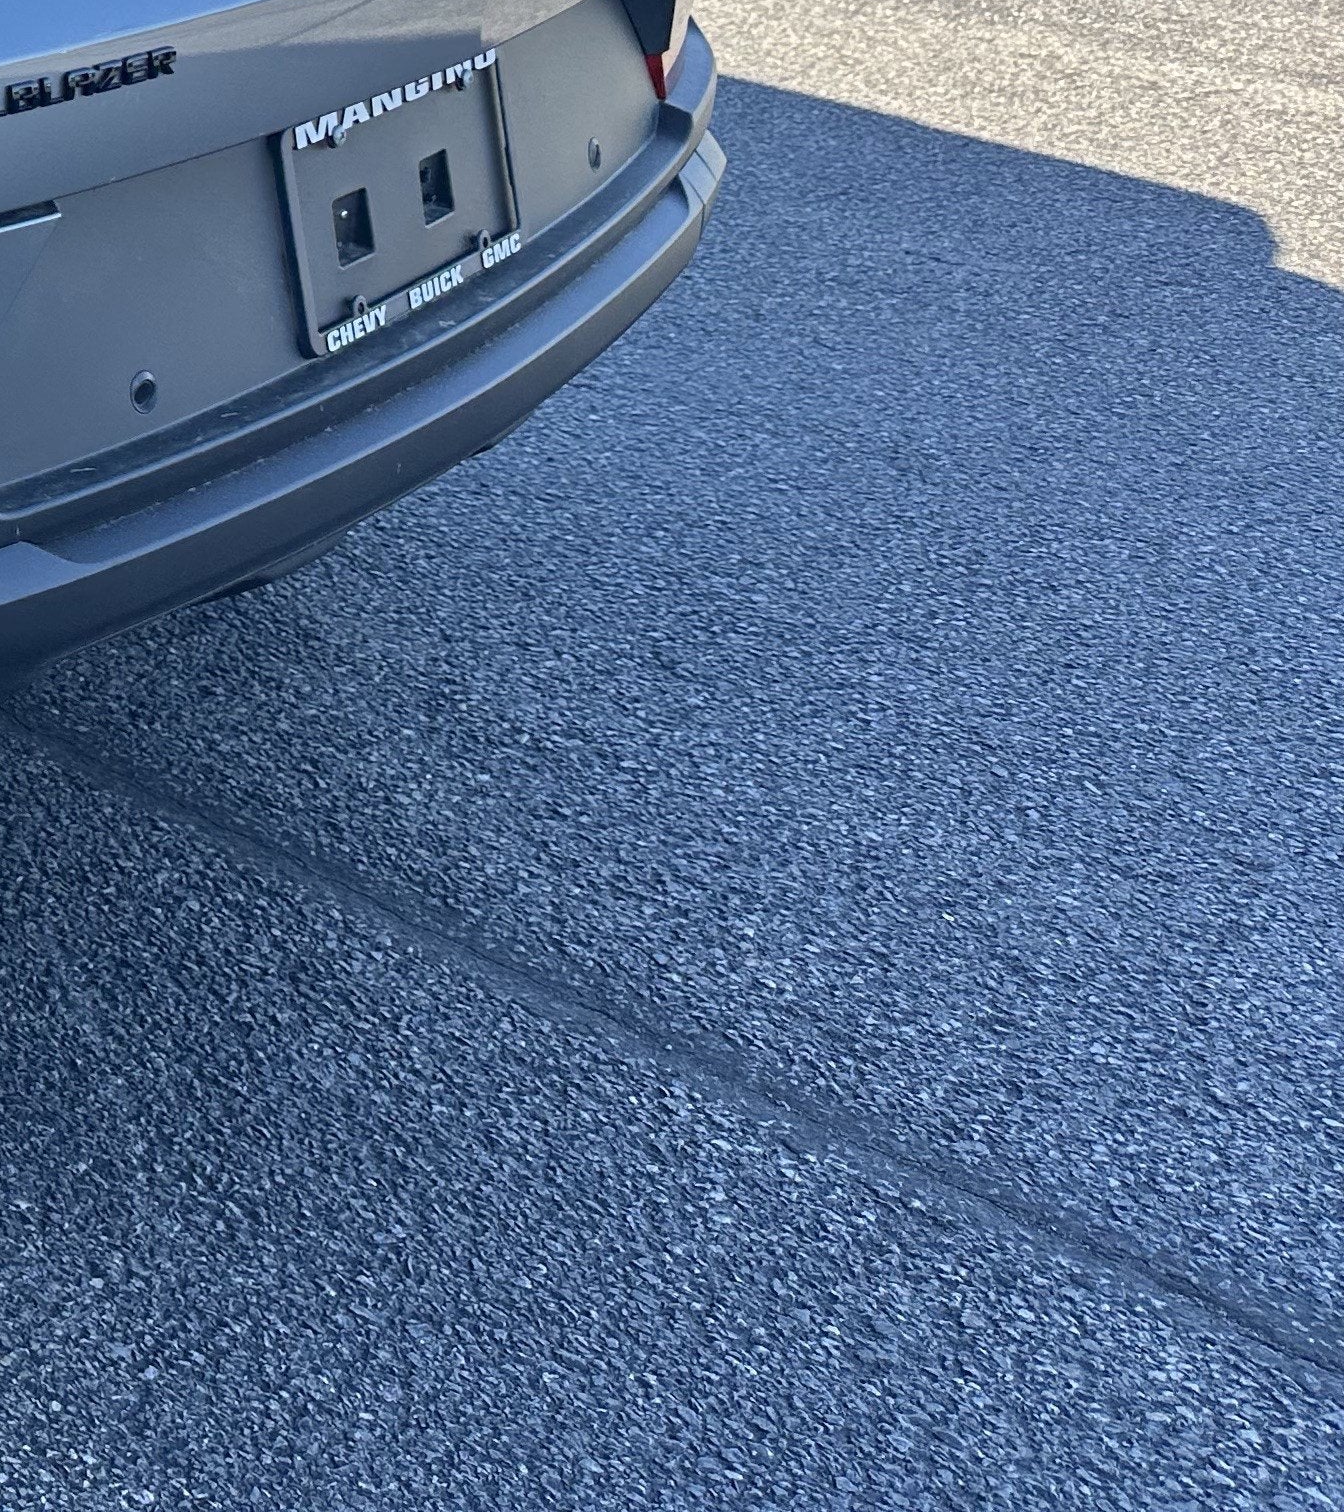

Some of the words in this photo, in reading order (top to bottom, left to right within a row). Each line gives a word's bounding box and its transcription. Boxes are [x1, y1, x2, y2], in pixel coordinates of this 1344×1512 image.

[326, 304, 388, 353] CHEVY
[408, 264, 464, 310] BUICK
[480, 233, 523, 269] GMC
